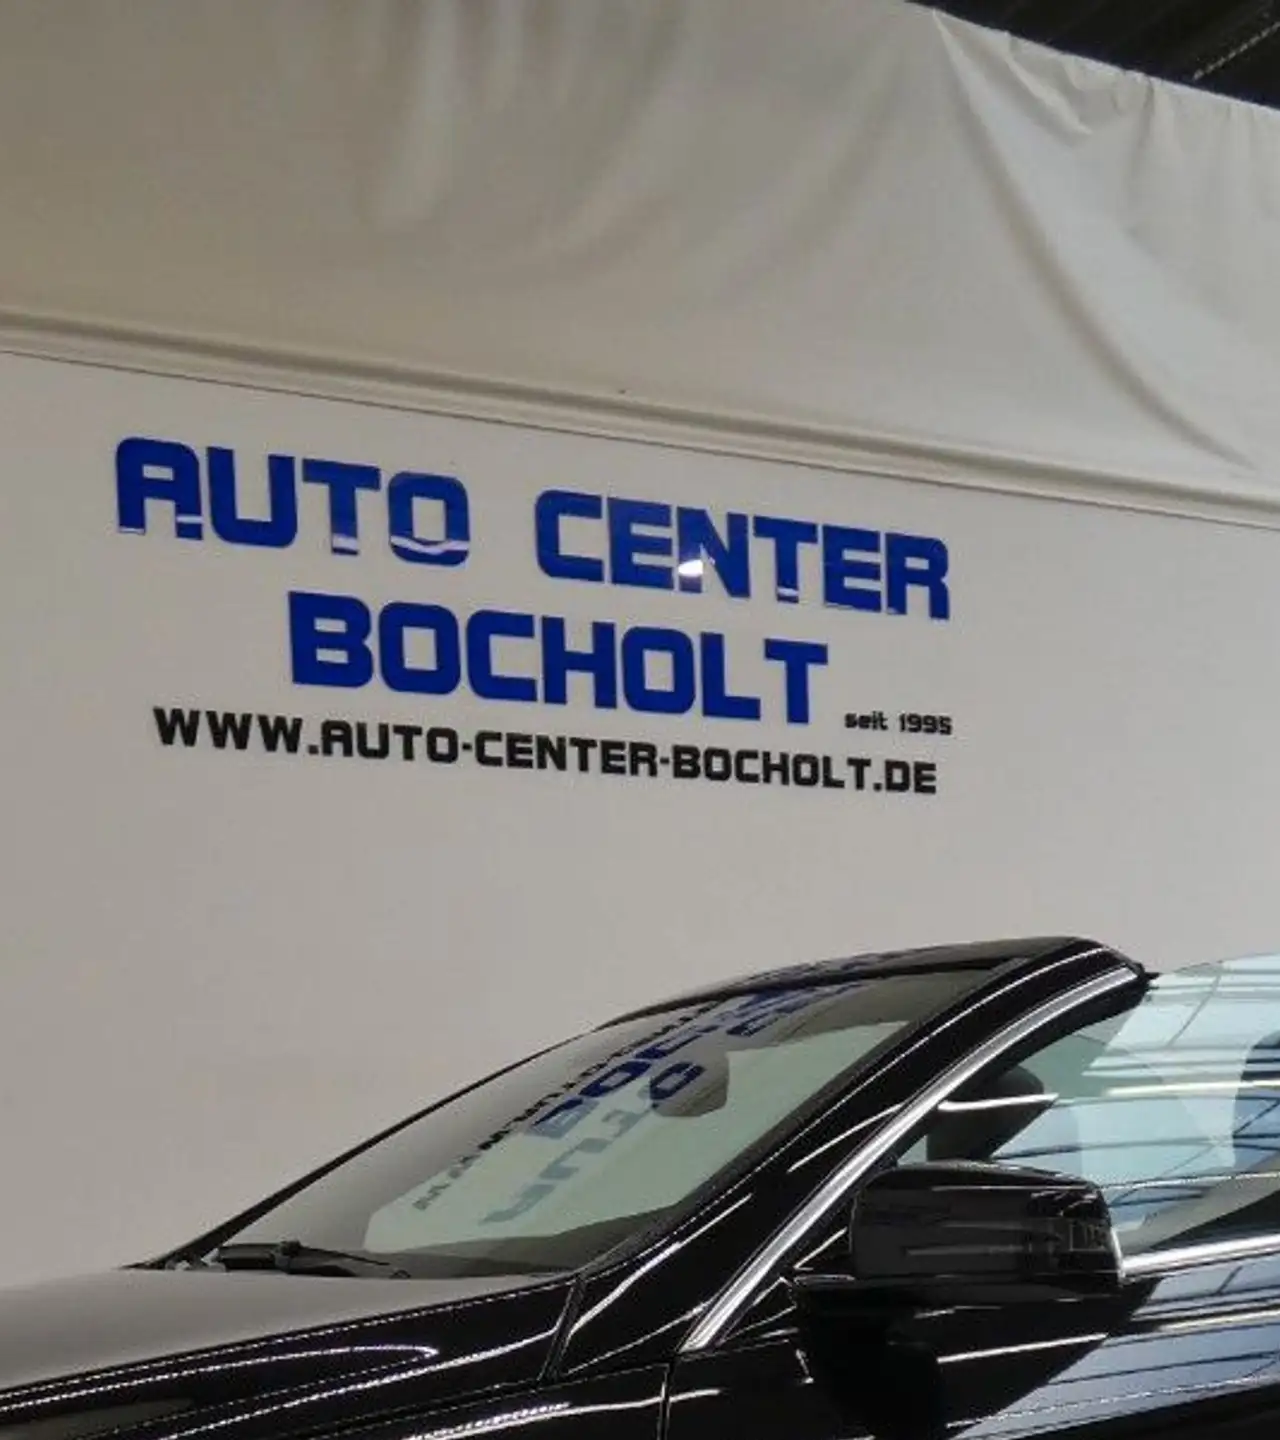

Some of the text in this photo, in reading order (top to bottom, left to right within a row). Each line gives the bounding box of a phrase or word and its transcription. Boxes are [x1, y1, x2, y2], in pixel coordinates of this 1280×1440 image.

[114, 436, 951, 620] AUTO CENTER
[287, 590, 829, 725] BOCHOLT
[152, 707, 937, 795] WWW.AUTO-CENTER-BOCHOLT.DE
[844, 710, 952, 735] seit 1995
